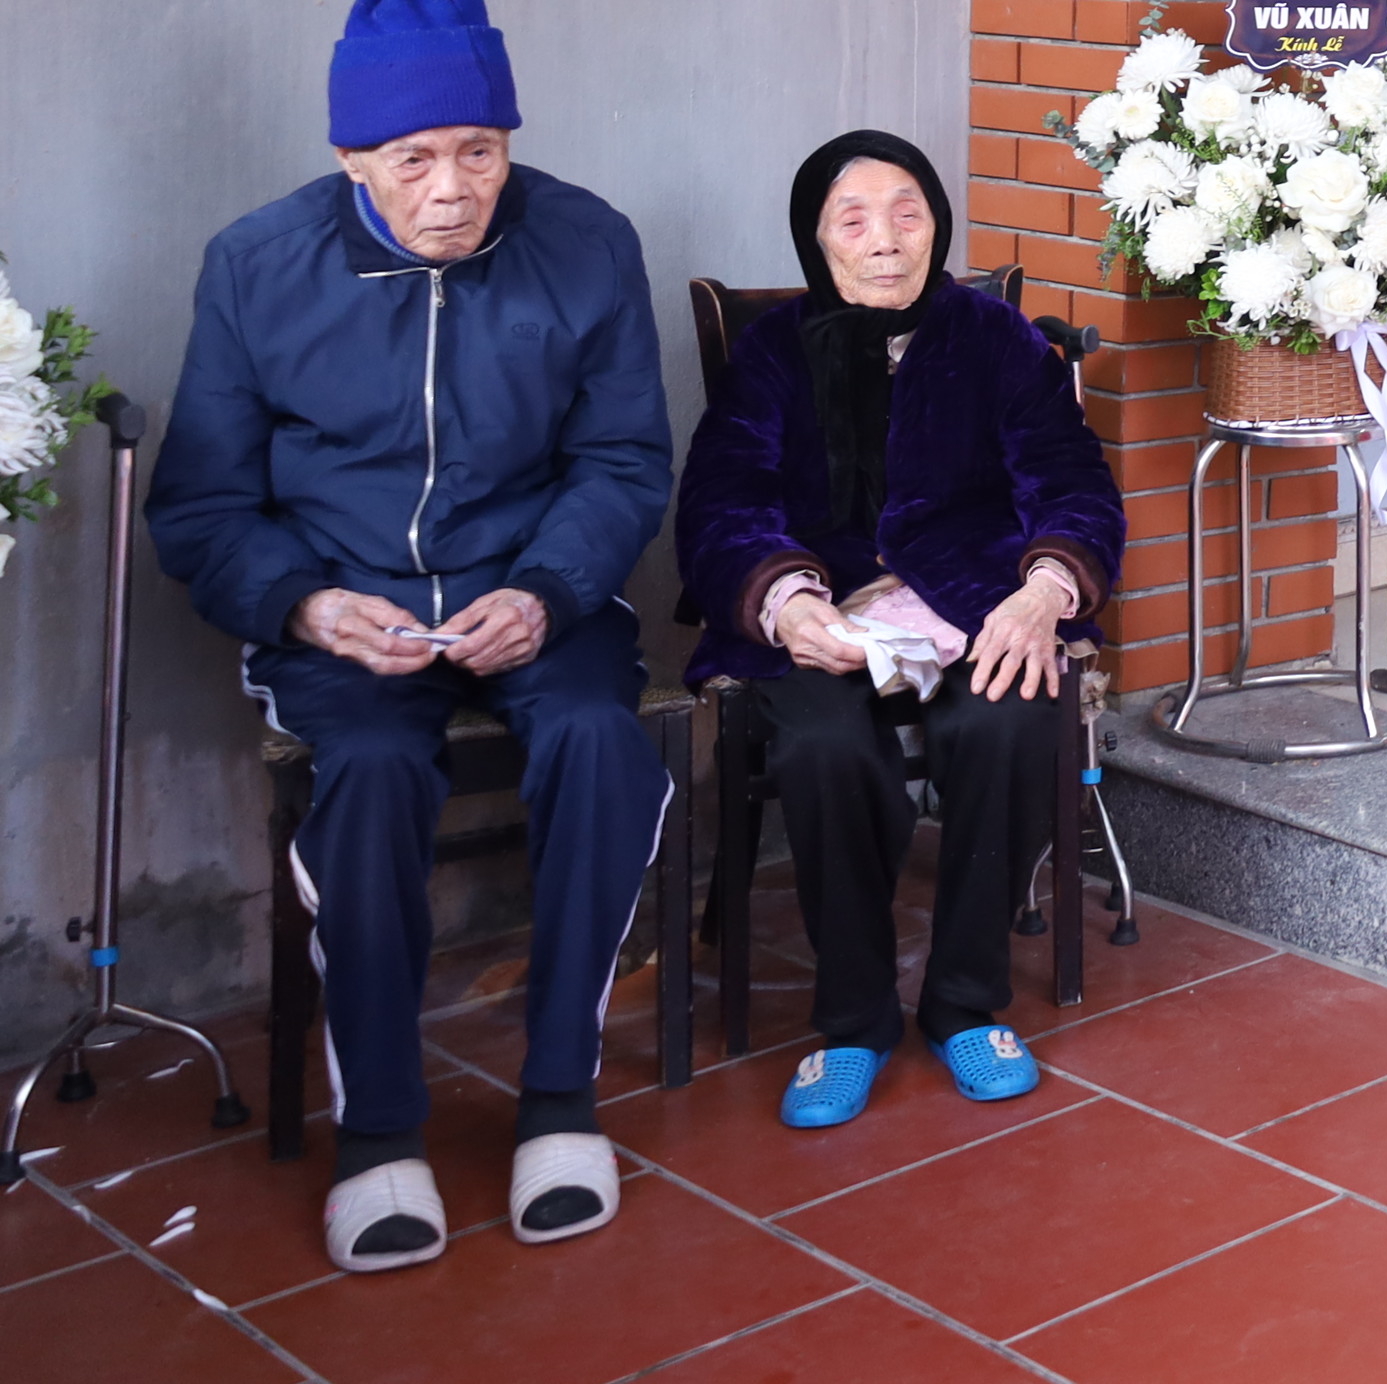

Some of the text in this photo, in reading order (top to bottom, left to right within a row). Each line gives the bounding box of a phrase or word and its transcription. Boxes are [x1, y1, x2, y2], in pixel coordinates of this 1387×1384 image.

[1254, 2, 1370, 30] VŨ XUÂN
[1274, 35, 1345, 52] Kính Lễ
